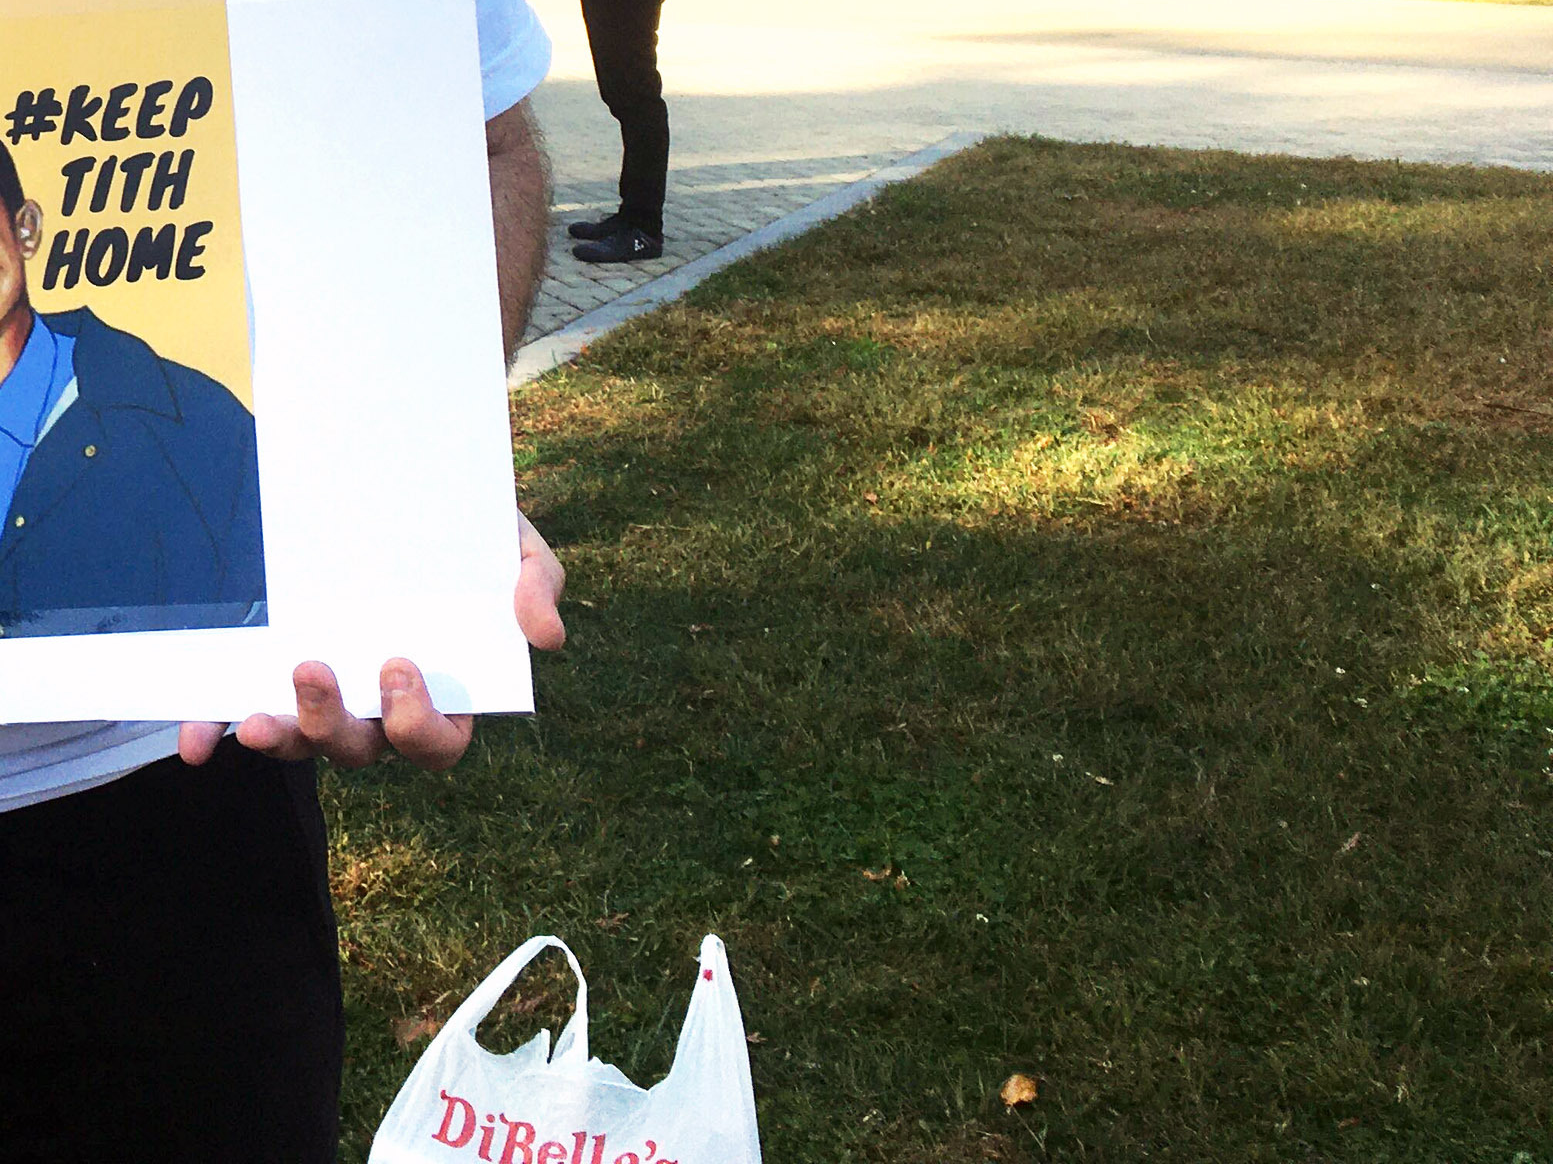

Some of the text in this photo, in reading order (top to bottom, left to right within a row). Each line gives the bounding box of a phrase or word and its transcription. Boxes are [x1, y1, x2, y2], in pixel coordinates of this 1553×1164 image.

[4, 76, 214, 145] #KEEP
[61, 149, 195, 217] TITH
[42, 221, 214, 290] HOME
